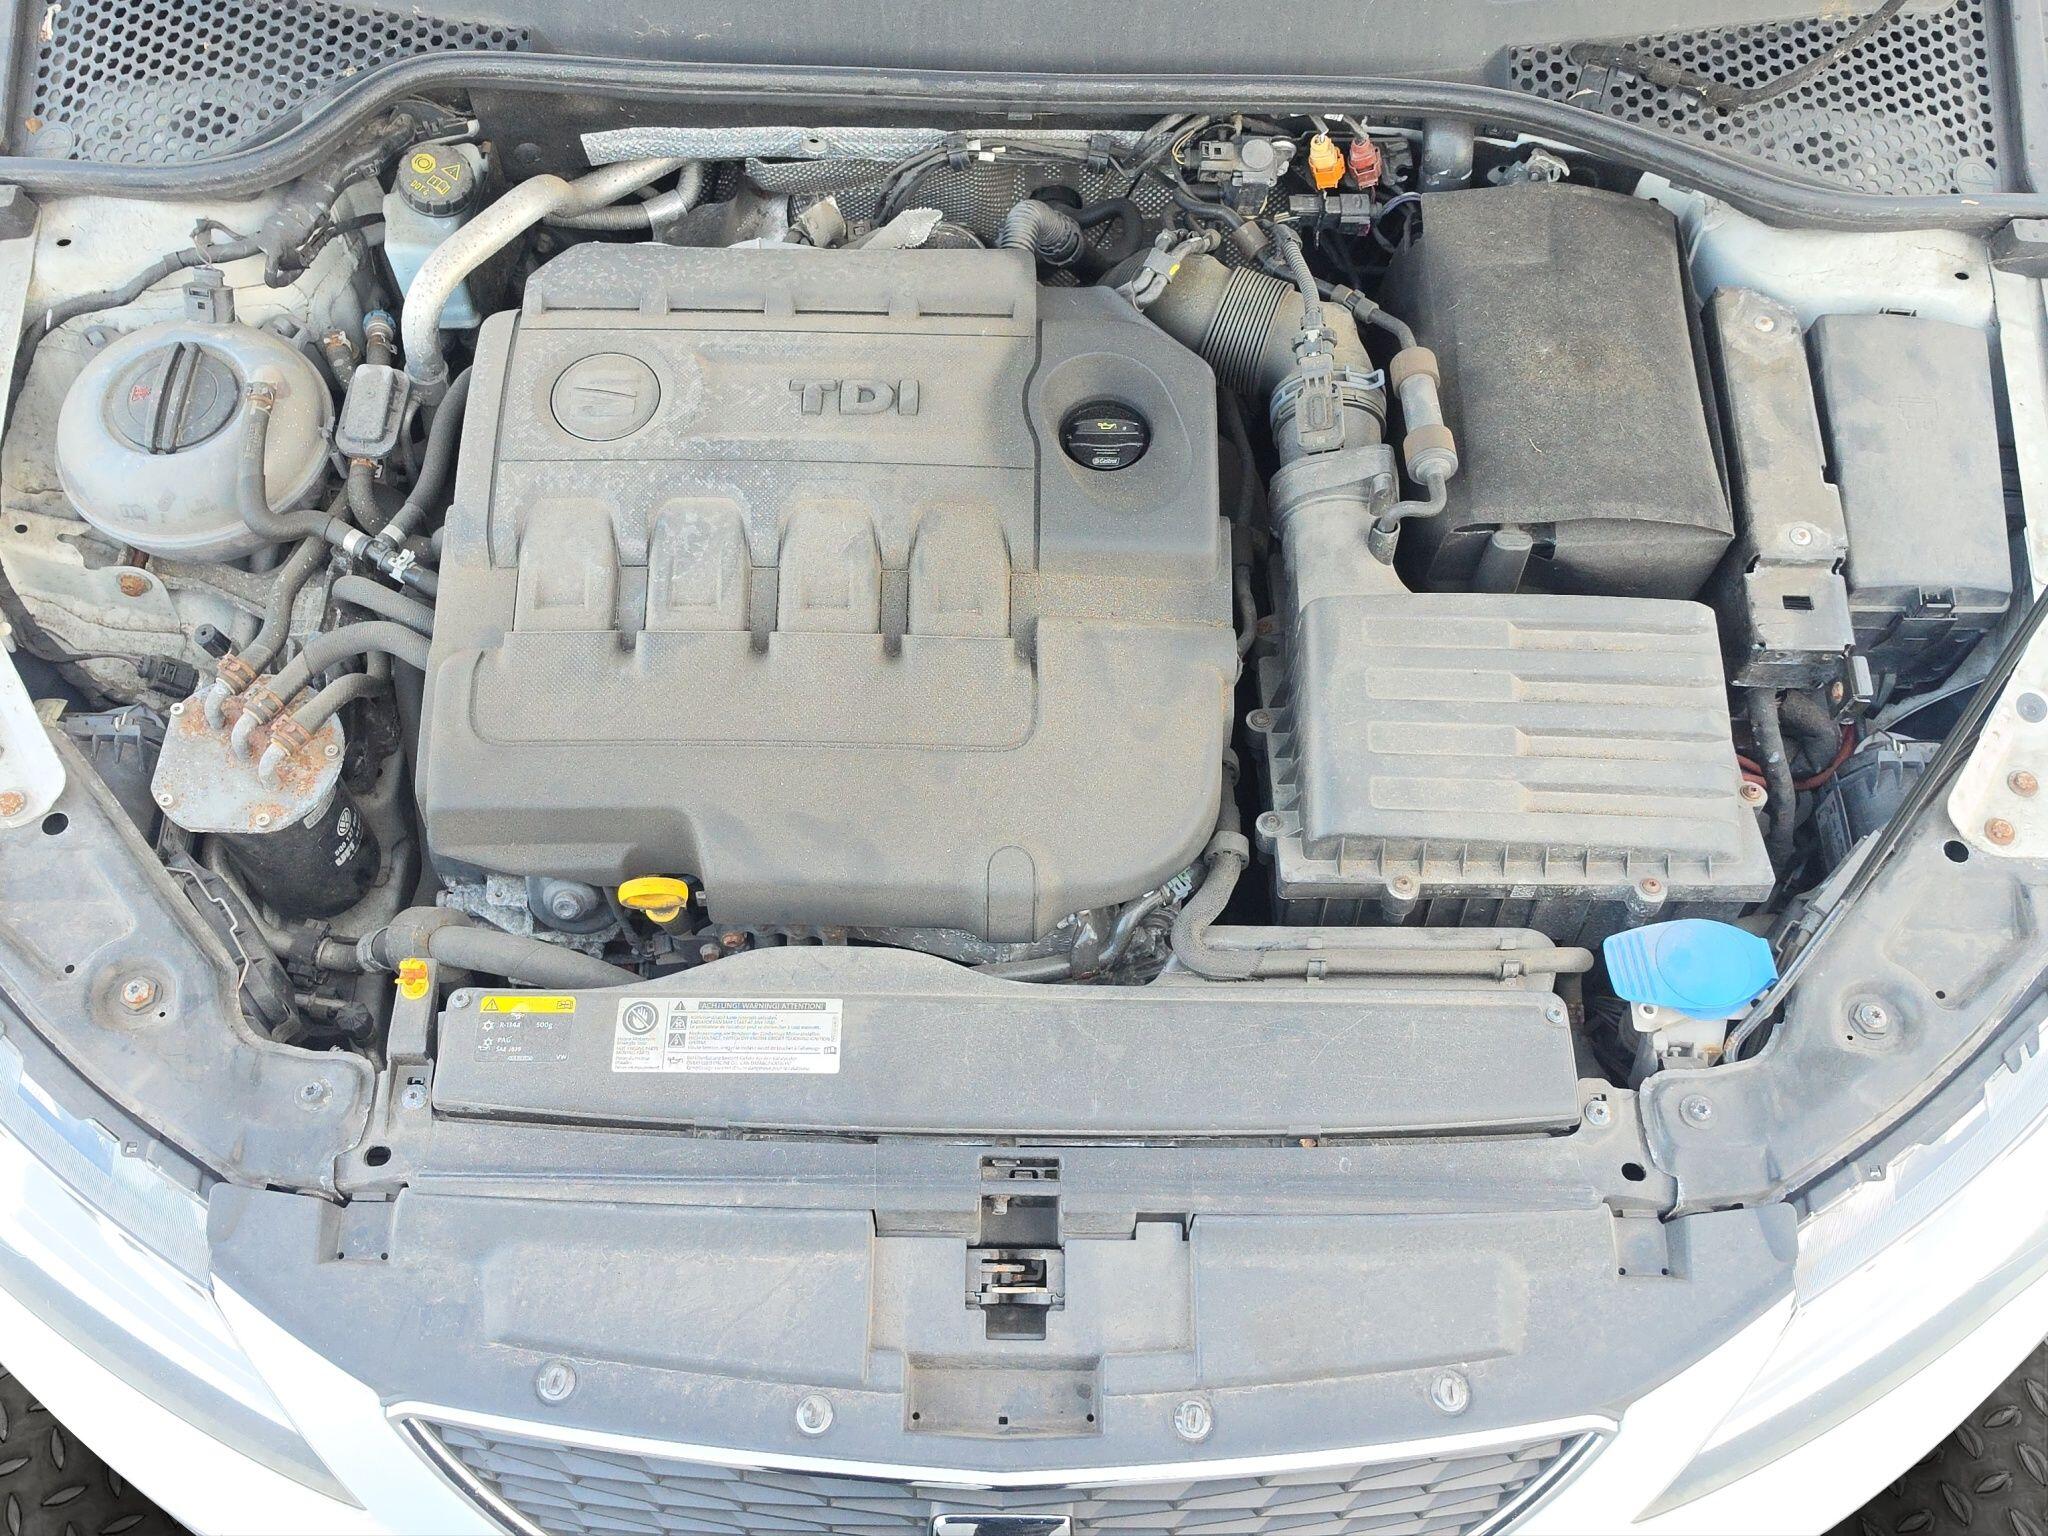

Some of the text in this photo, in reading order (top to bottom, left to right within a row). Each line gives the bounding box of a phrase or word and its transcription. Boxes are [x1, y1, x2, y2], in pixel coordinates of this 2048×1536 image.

[410, 180, 425, 191] DOT
[789, 379, 920, 416] TDI
[742, 1002, 780, 1010] WARNING!
